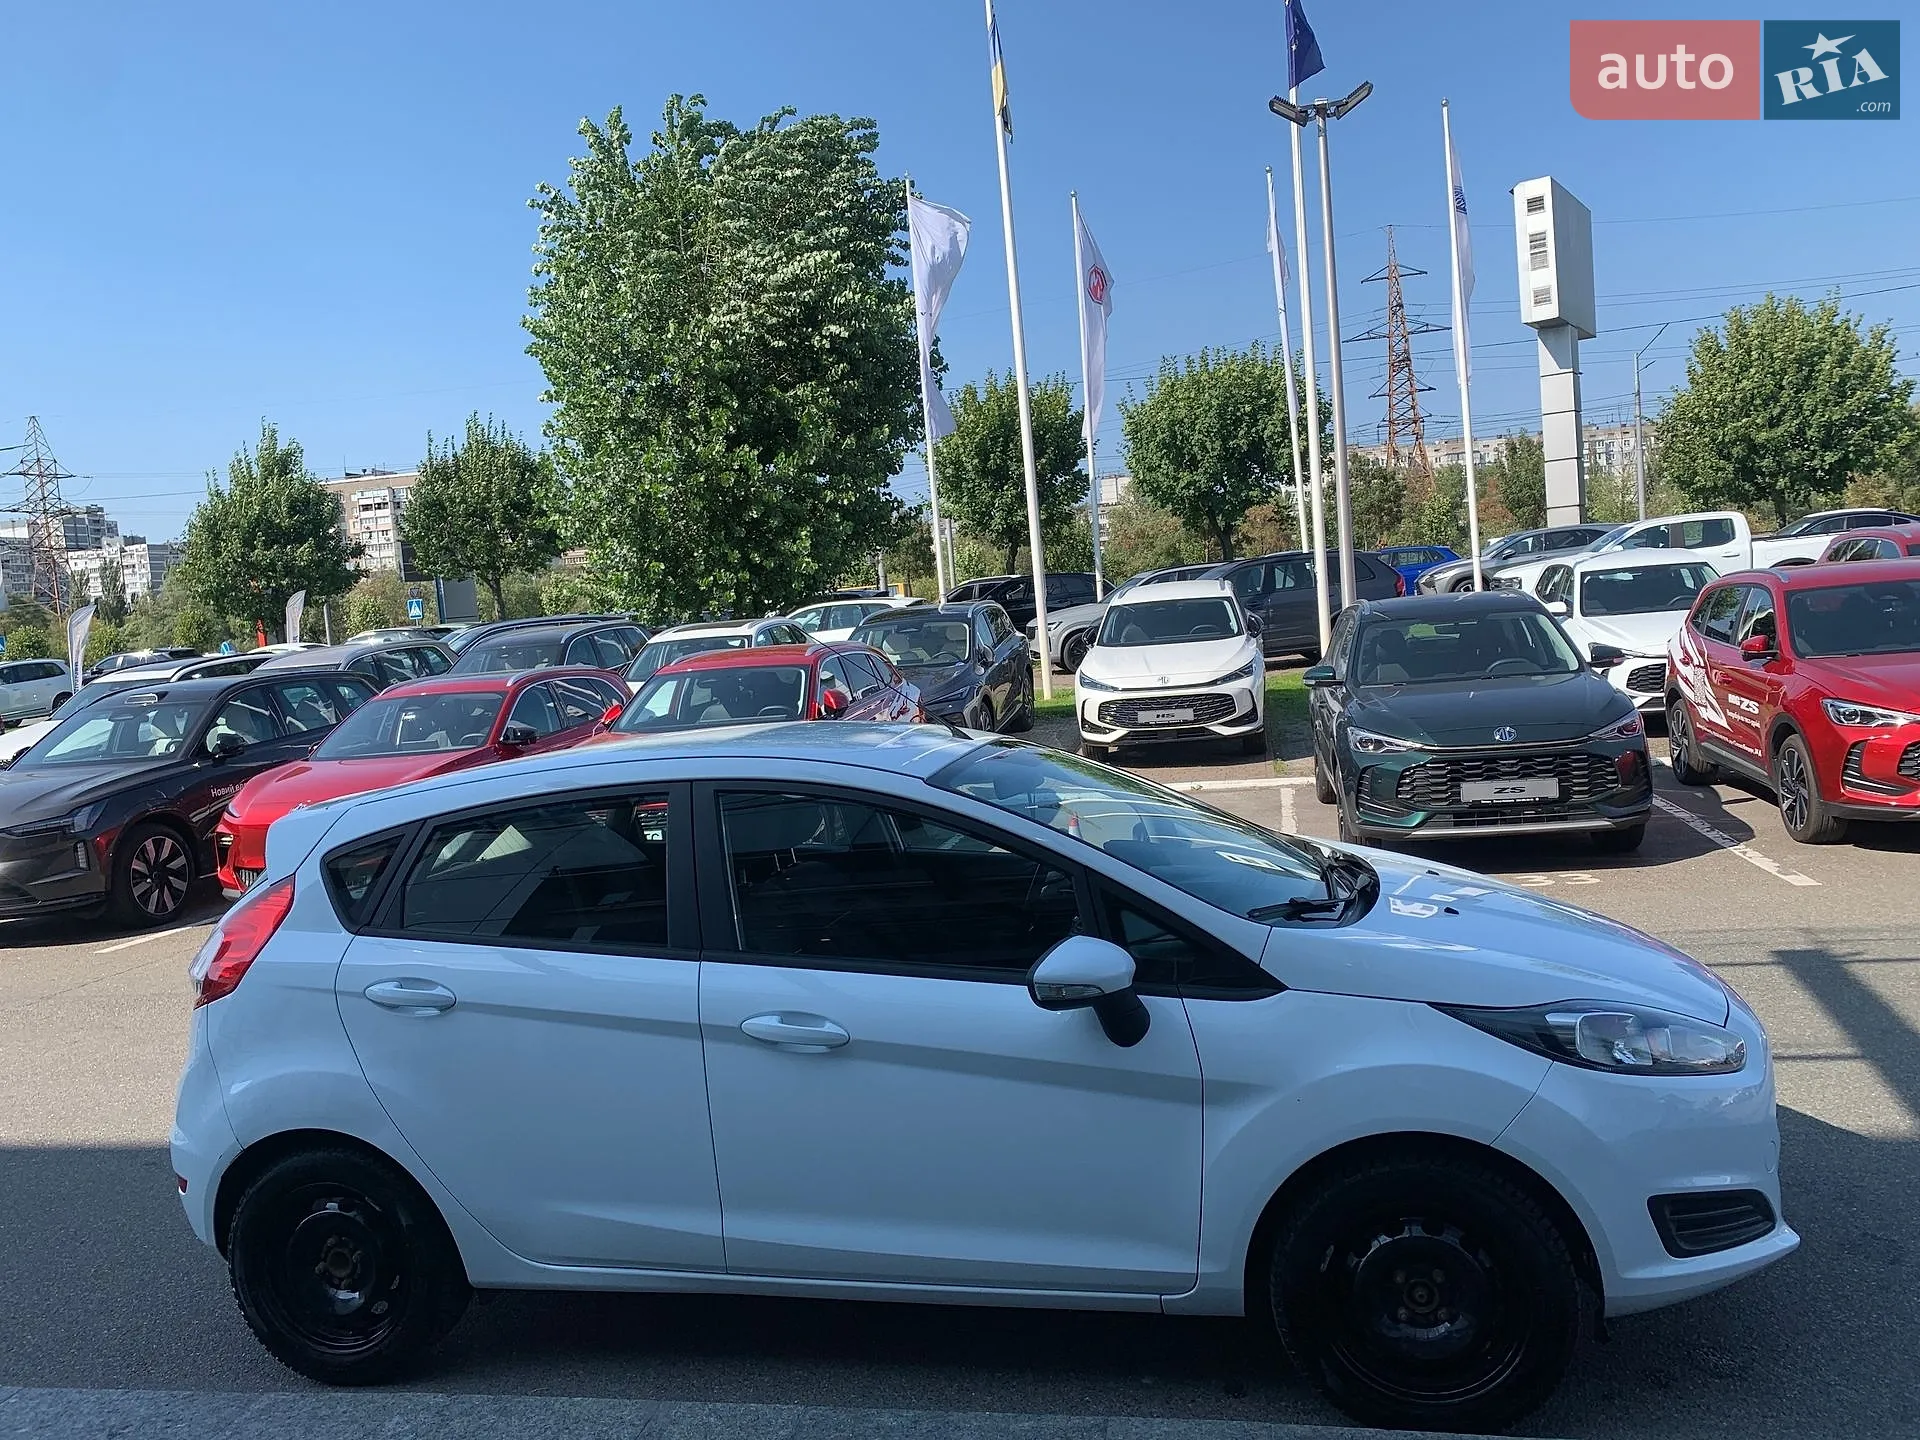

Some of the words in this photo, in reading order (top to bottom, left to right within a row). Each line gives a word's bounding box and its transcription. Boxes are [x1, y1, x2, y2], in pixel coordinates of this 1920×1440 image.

[1740, 697, 1760, 715] ZS
[1494, 726, 1517, 742] MG
[210, 783, 235, 798] Новий
[1493, 786, 1526, 795] ZS
[1515, 873, 1601, 887] 33
